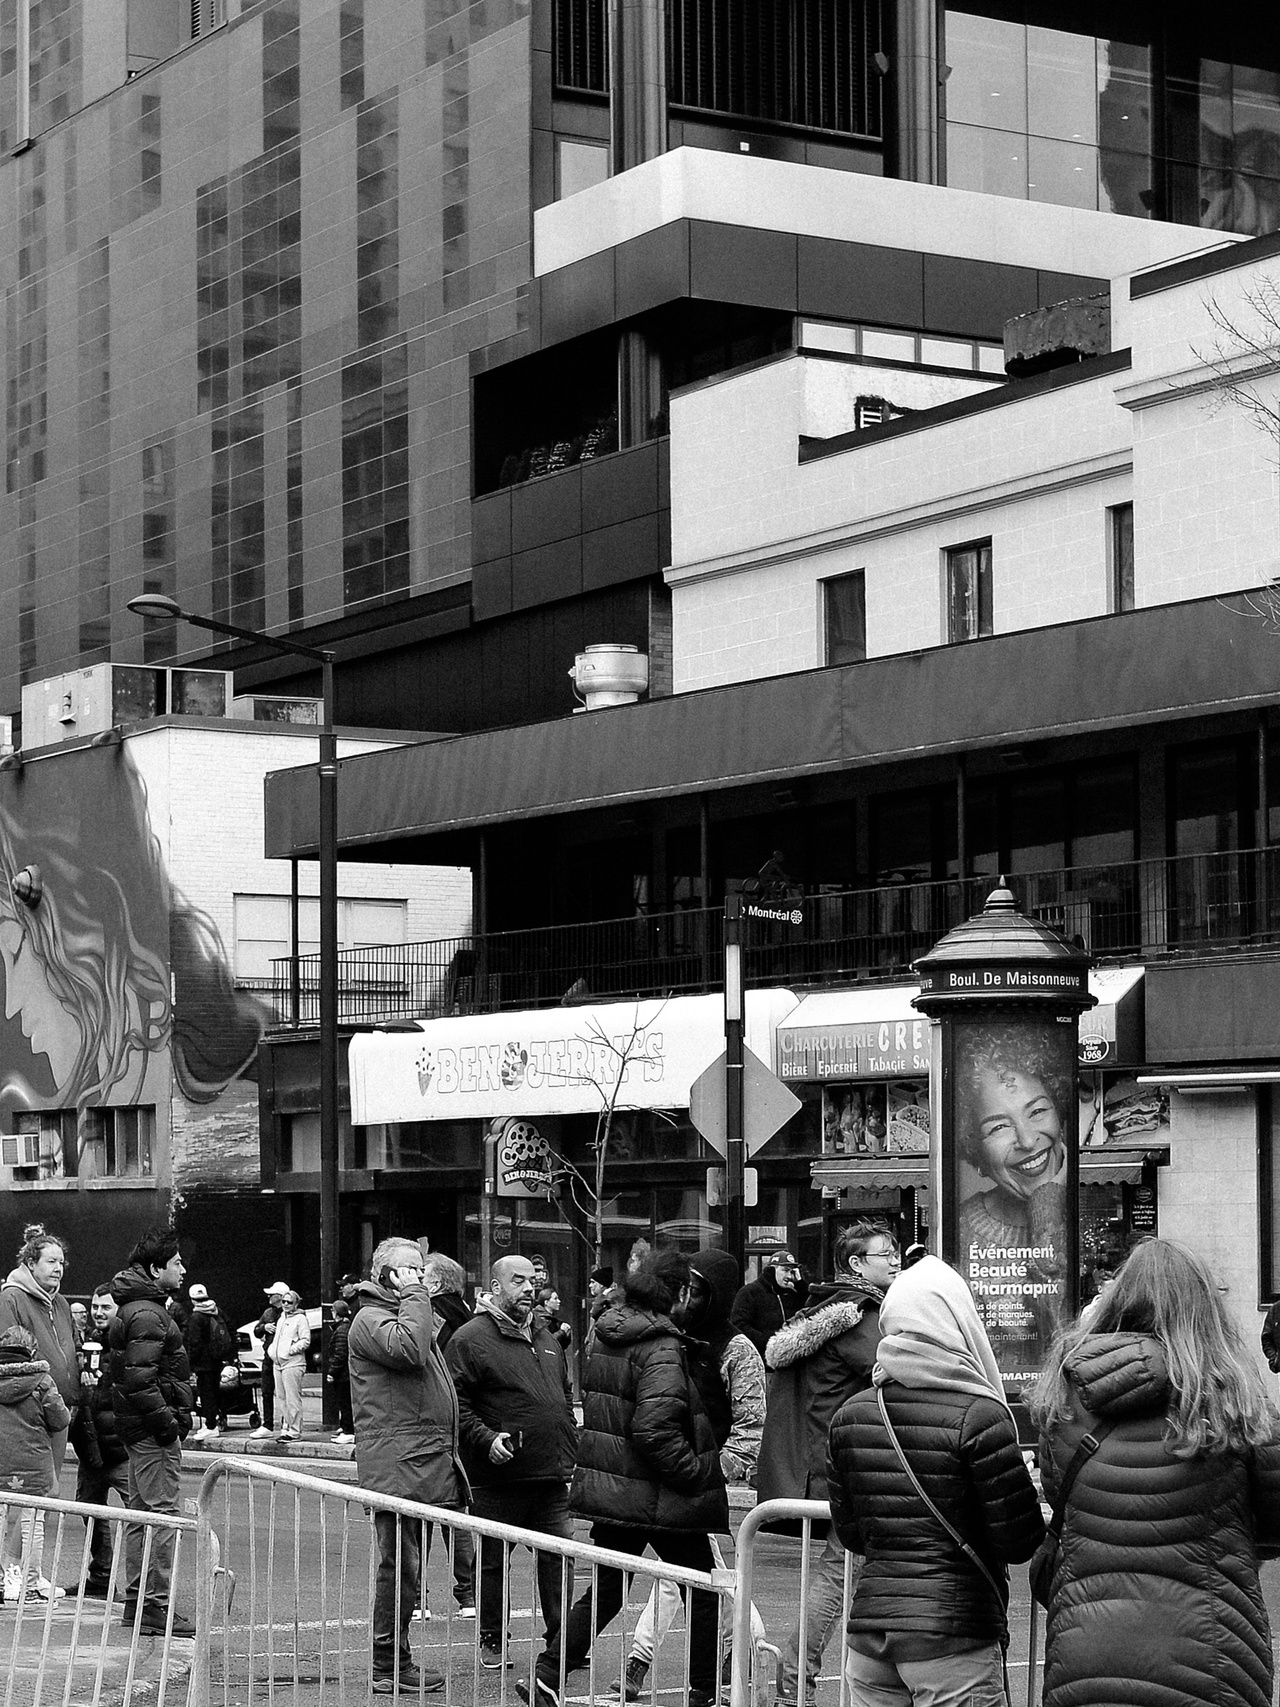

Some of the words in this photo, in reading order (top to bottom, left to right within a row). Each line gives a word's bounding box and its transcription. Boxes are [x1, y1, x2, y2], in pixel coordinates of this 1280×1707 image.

[748, 904, 790, 921] Montréal
[949, 973, 980, 987] Boul.
[983, 972, 1002, 986] De
[1006, 971, 1080, 987] Maisonneuve
[877, 1020, 931, 1052] CRE
[436, 1044, 501, 1094] BEN
[526, 1032, 665, 1088] JERRY'S
[1082, 1050, 1102, 1060] 1968
[969, 1240, 1055, 1260] Événement
[969, 1261, 1028, 1278] Beauté
[970, 1279, 1059, 1298] Pharmaprix
[986, 1301, 997, 1311] de
[998, 1302, 1026, 1312] points.
[986, 1310, 997, 1319] de
[998, 1311, 1035, 1321] marques.
[986, 1318, 997, 1327] de
[998, 1318, 1029, 1327] beauté.
[999, 1373, 1044, 1381] RMAPRI
